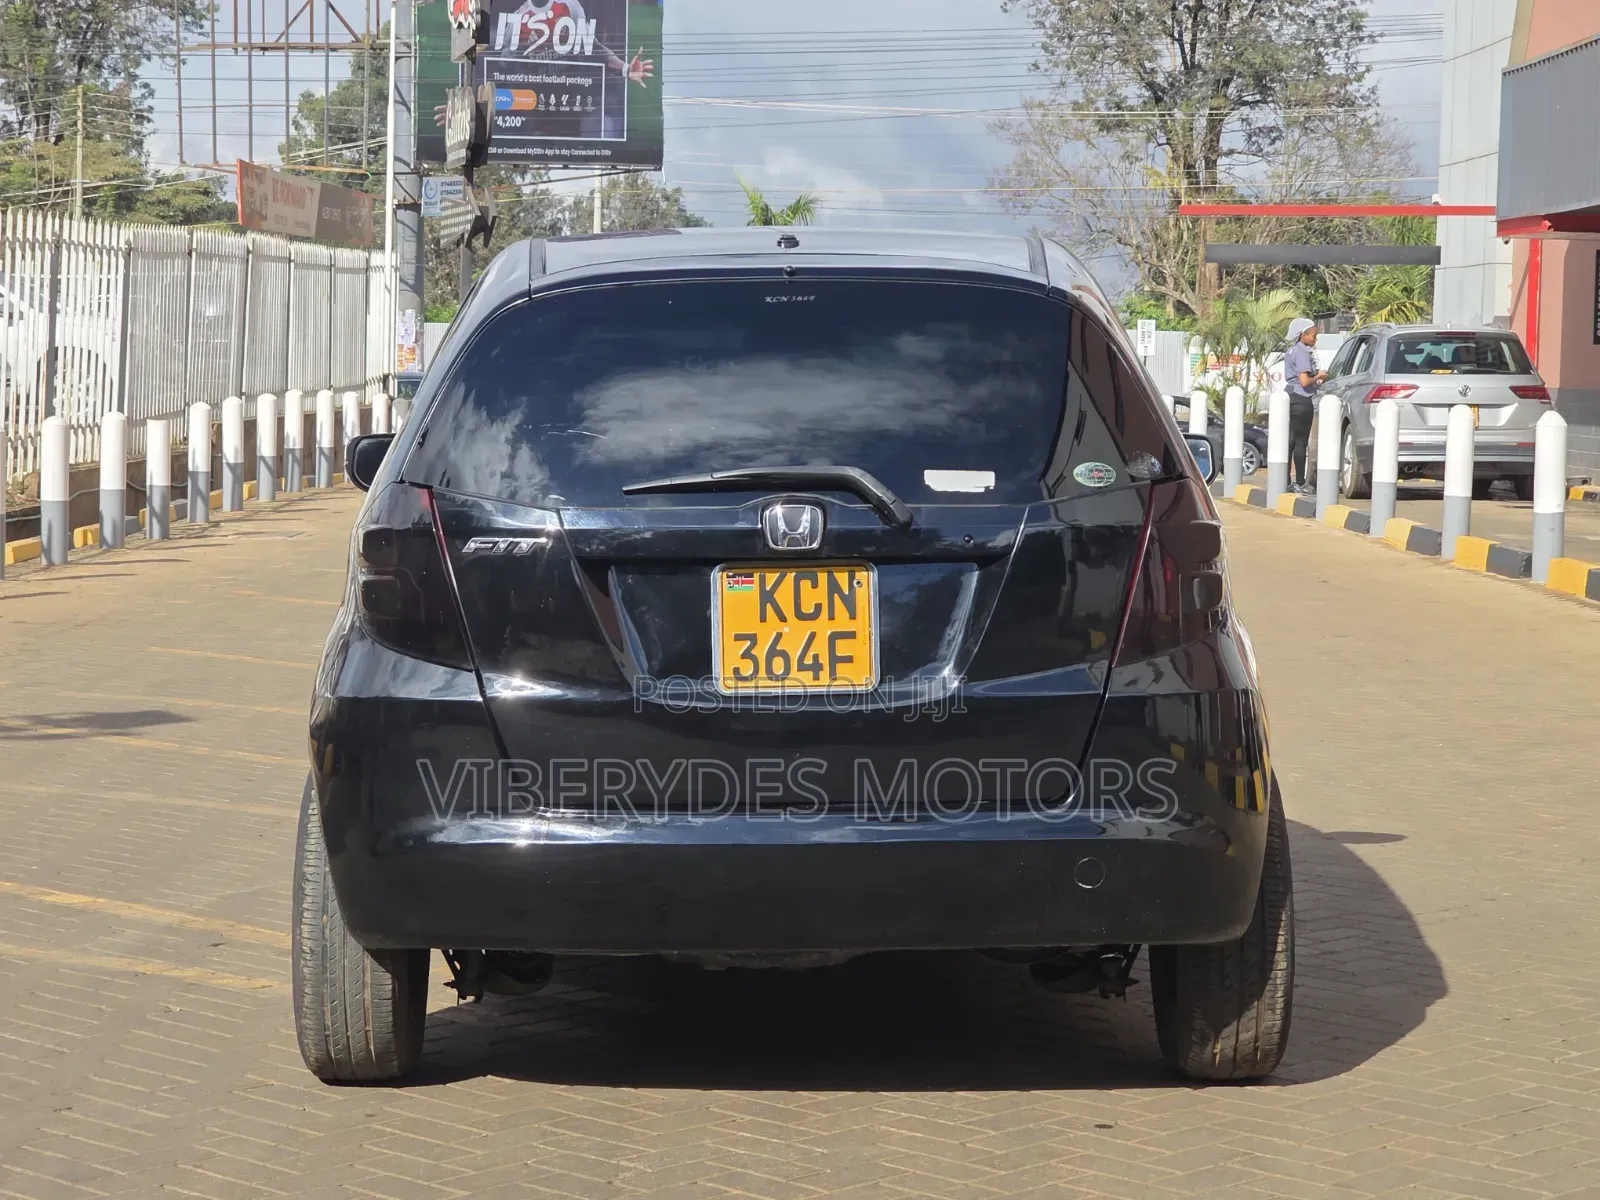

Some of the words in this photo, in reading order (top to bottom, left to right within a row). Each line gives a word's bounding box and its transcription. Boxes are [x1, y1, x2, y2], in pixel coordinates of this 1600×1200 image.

[494, 10, 554, 56] IT'S
[553, 16, 597, 56] ON
[494, 72, 505, 81] The
[506, 73, 528, 82] world's
[529, 74, 542, 83] best
[543, 74, 566, 85] football
[567, 76, 593, 87] package
[503, 147, 527, 155] Download
[545, 148, 555, 157] App
[560, 148, 571, 157] stay
[462, 537, 548, 555] FIT
[758, 570, 857, 623] KCN
[732, 630, 857, 682] 364F
